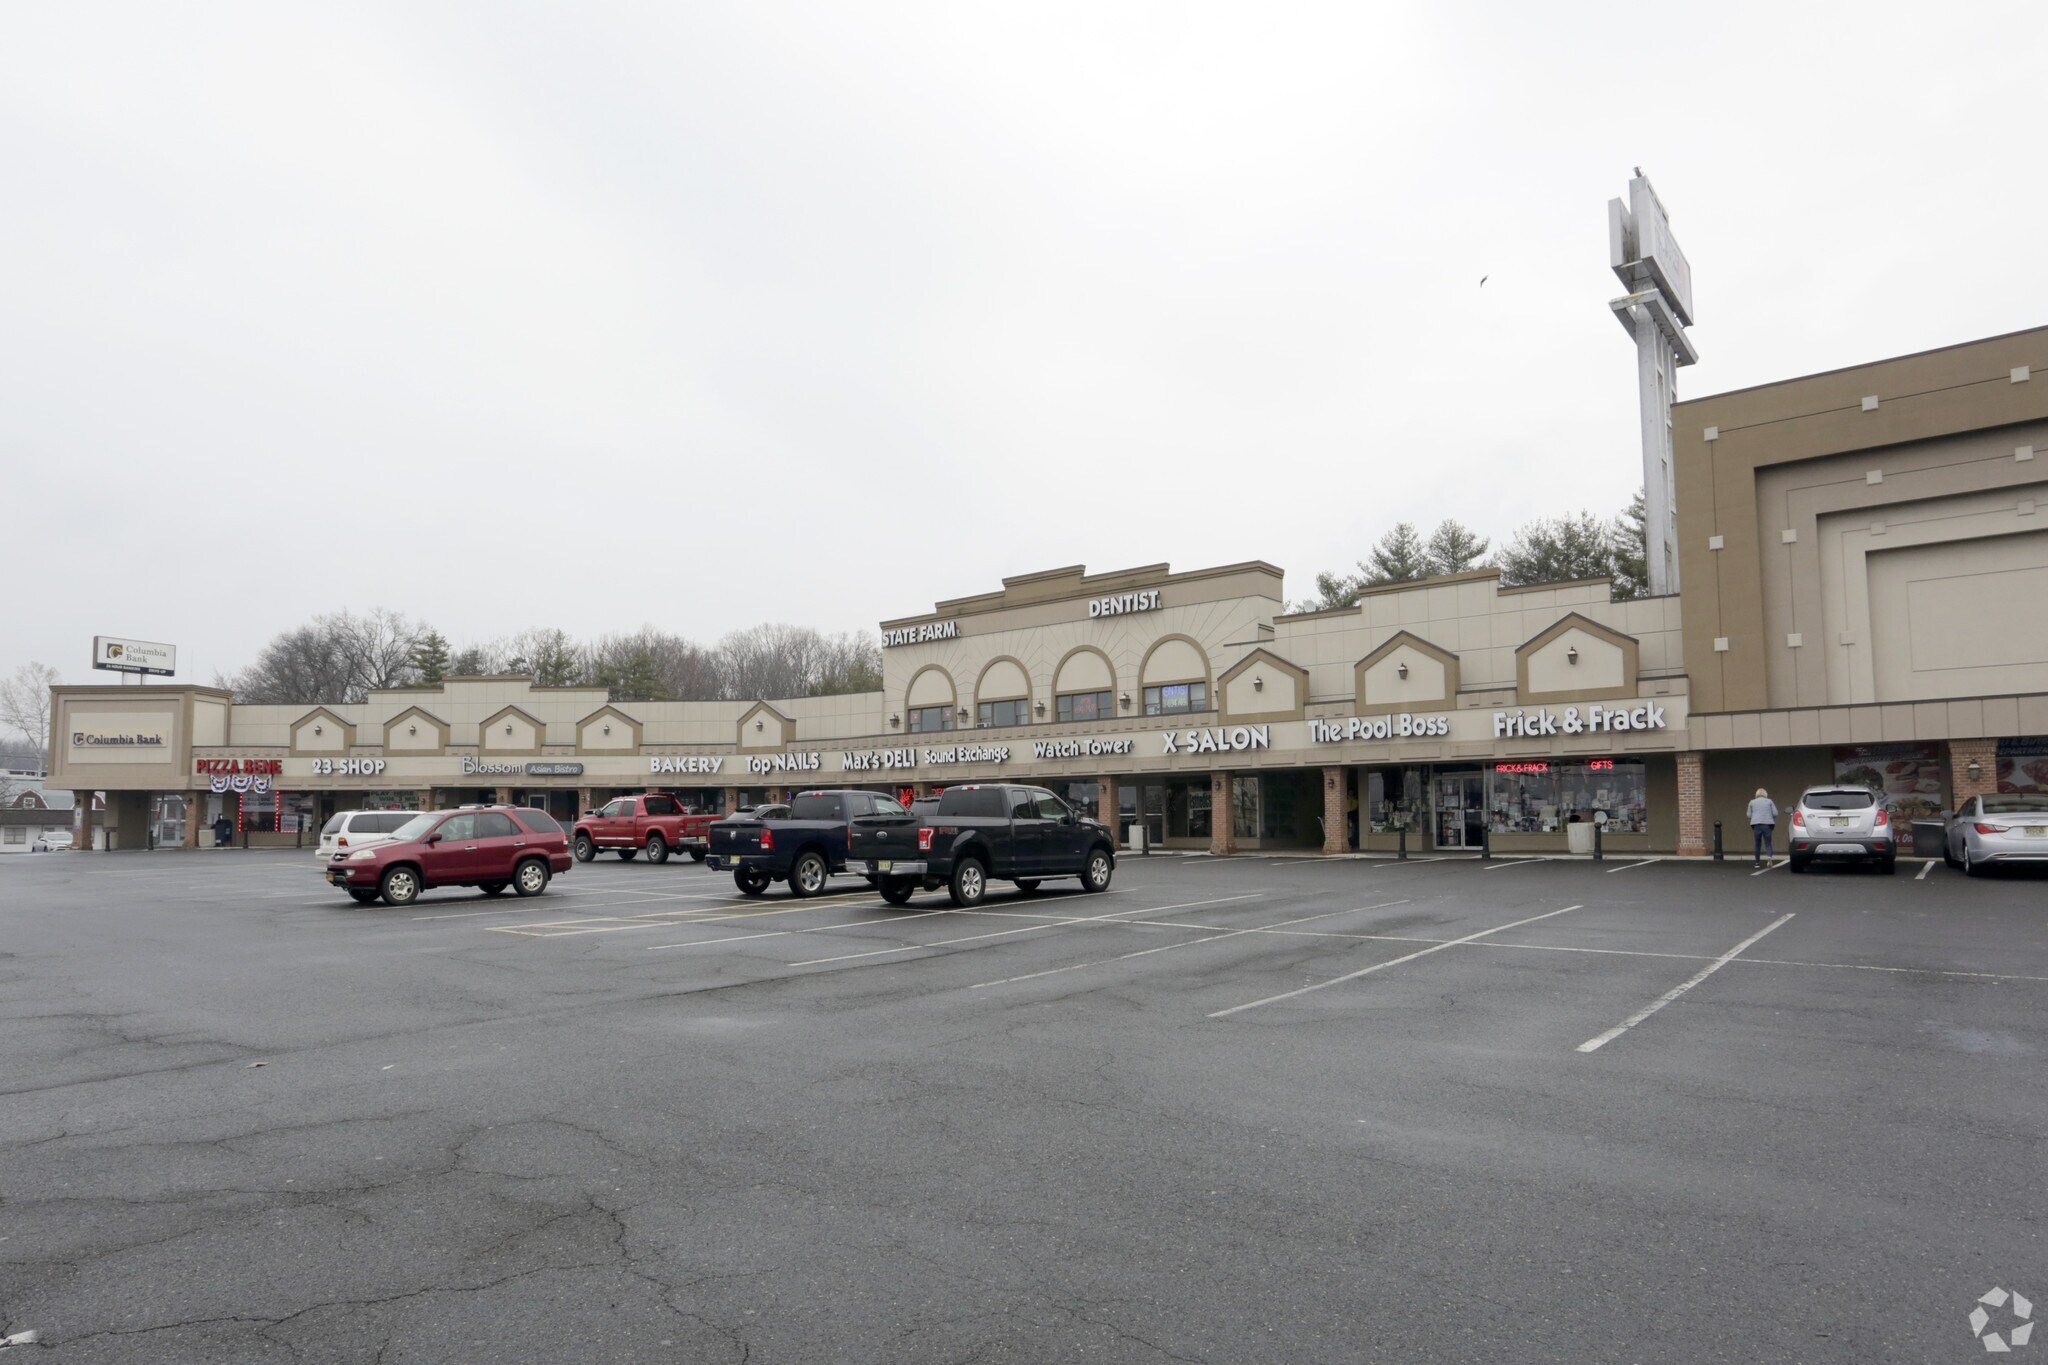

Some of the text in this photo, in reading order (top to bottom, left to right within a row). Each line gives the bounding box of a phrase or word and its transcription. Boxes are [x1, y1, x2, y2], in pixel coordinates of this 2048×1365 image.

[1088, 590, 1160, 618] DENTIST
[882, 621, 957, 647] STATE FARM
[126, 645, 167, 657] Columbia
[126, 653, 148, 663] Bank
[1308, 713, 1449, 742] The Pool Boss
[1493, 701, 1666, 738] Frick & Frack
[86, 734, 163, 745] Columbia Bank
[1162, 725, 1269, 753] X SALON
[924, 746, 1010, 764] Sound Exchange
[1033, 739, 1132, 758] Watch Tower
[197, 759, 282, 774] PIZZA BENE
[312, 758, 386, 775] 23 SHOP
[462, 756, 578, 774] Blossom Asian Bistro
[650, 757, 723, 773] BAKERY
[745, 752, 821, 775] Top NAILS
[842, 749, 917, 770] Max's DELI
[1496, 764, 1516, 773] FRICK
[1524, 762, 1548, 772] FRACK
[1590, 760, 1613, 770] GIFTS
